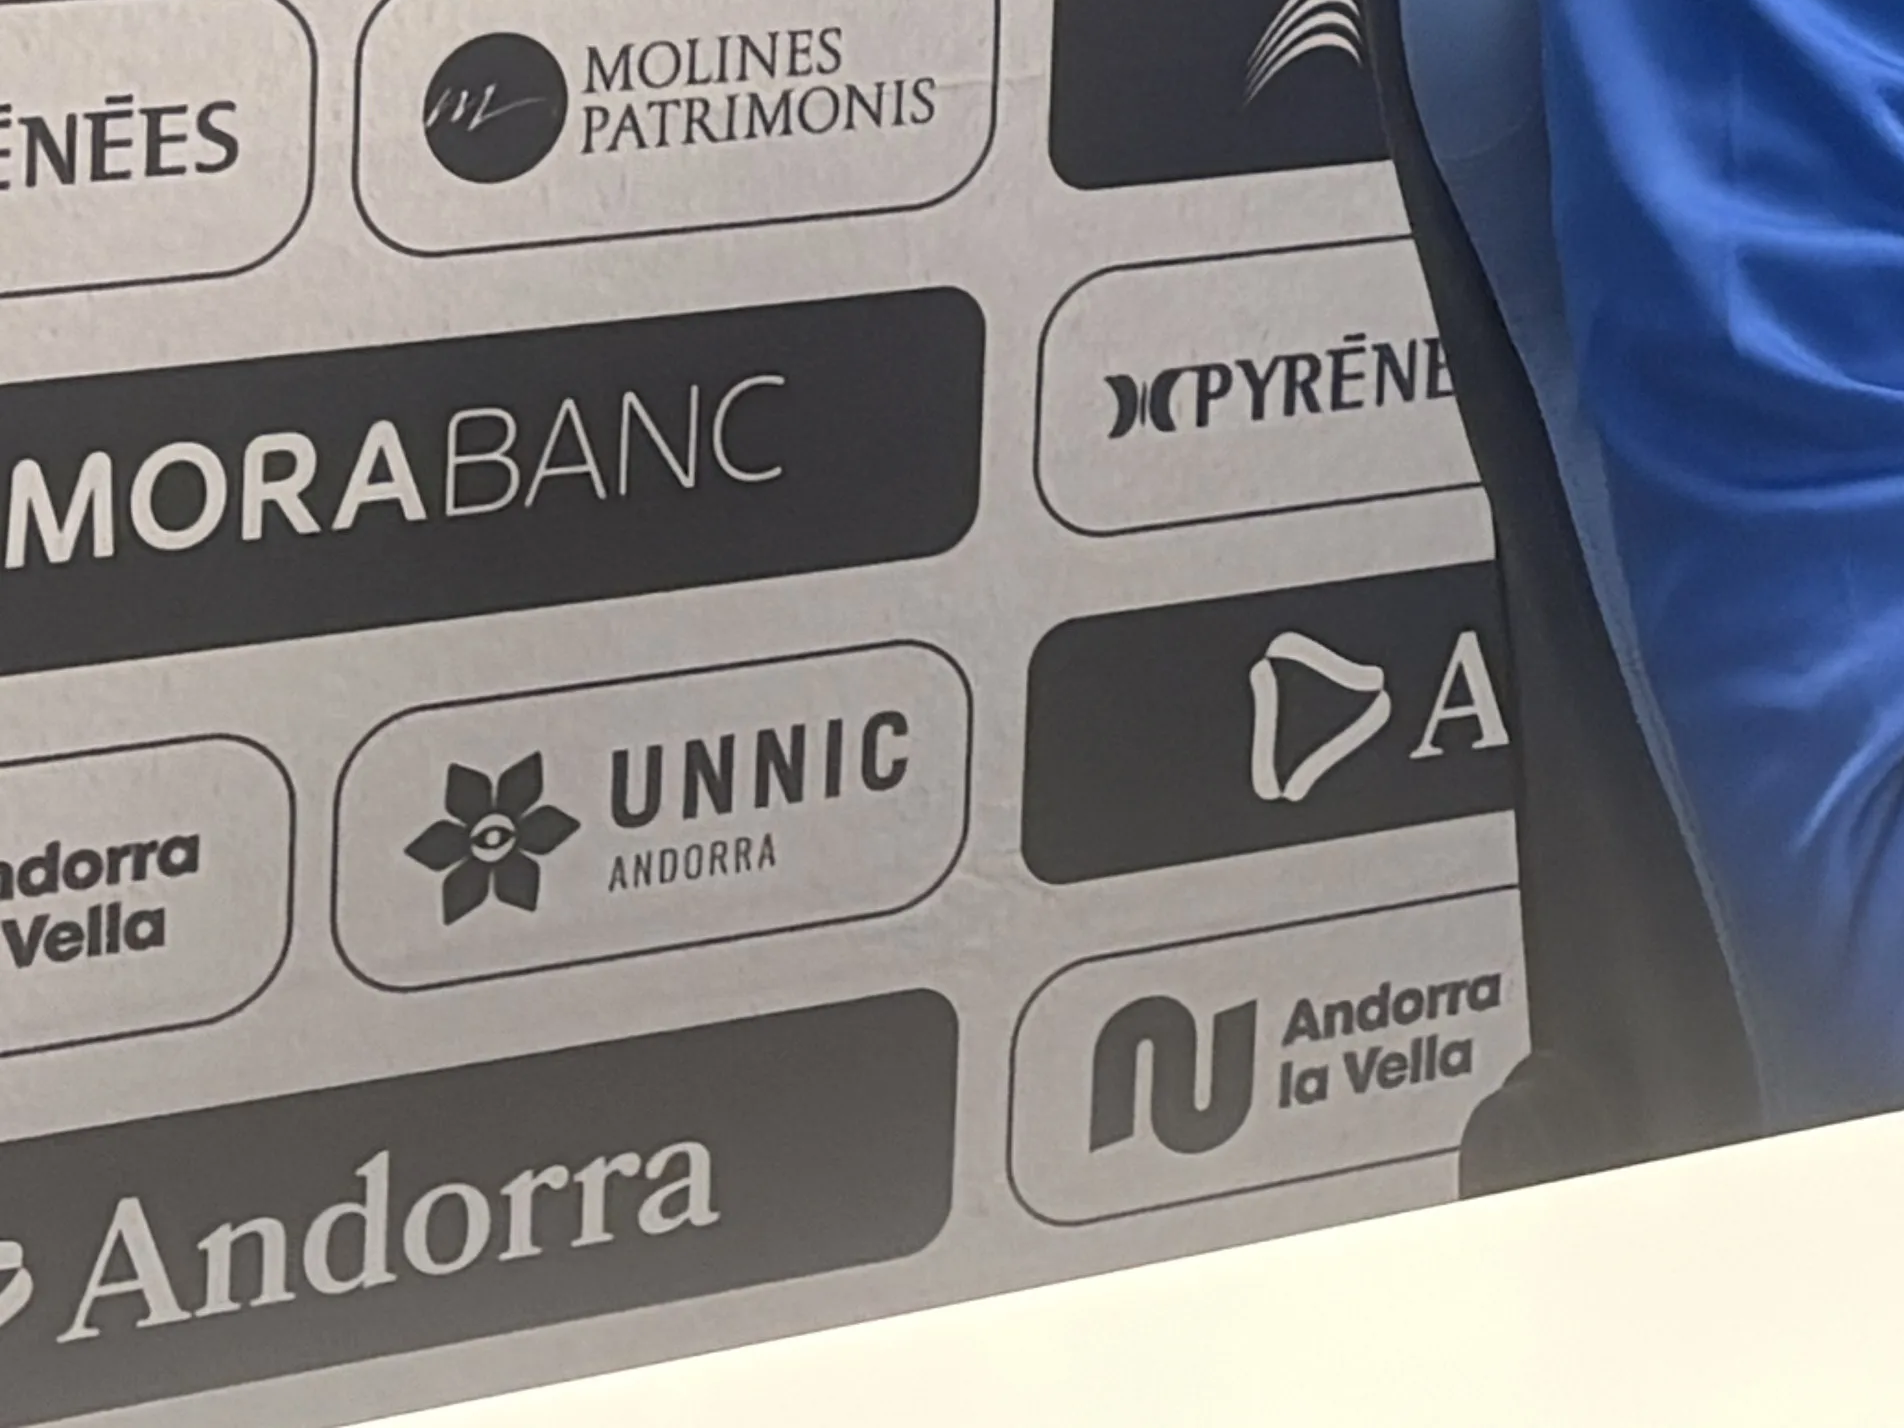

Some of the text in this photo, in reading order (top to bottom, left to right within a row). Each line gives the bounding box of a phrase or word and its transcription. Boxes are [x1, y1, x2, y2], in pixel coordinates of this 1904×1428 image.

[584, 27, 841, 93] MOLINES
[582, 78, 935, 154] PATRIMONIS
[6, 376, 783, 568] MORABANC
[612, 711, 908, 828] UNNIC
[0, 833, 200, 901] dorra
[608, 833, 776, 892] ANDORRA
[1, 901, 166, 969] Vella
[1282, 973, 1501, 1047] Andorra
[1279, 1034, 1472, 1108] la Vella
[57, 1142, 719, 1343] Andorra
